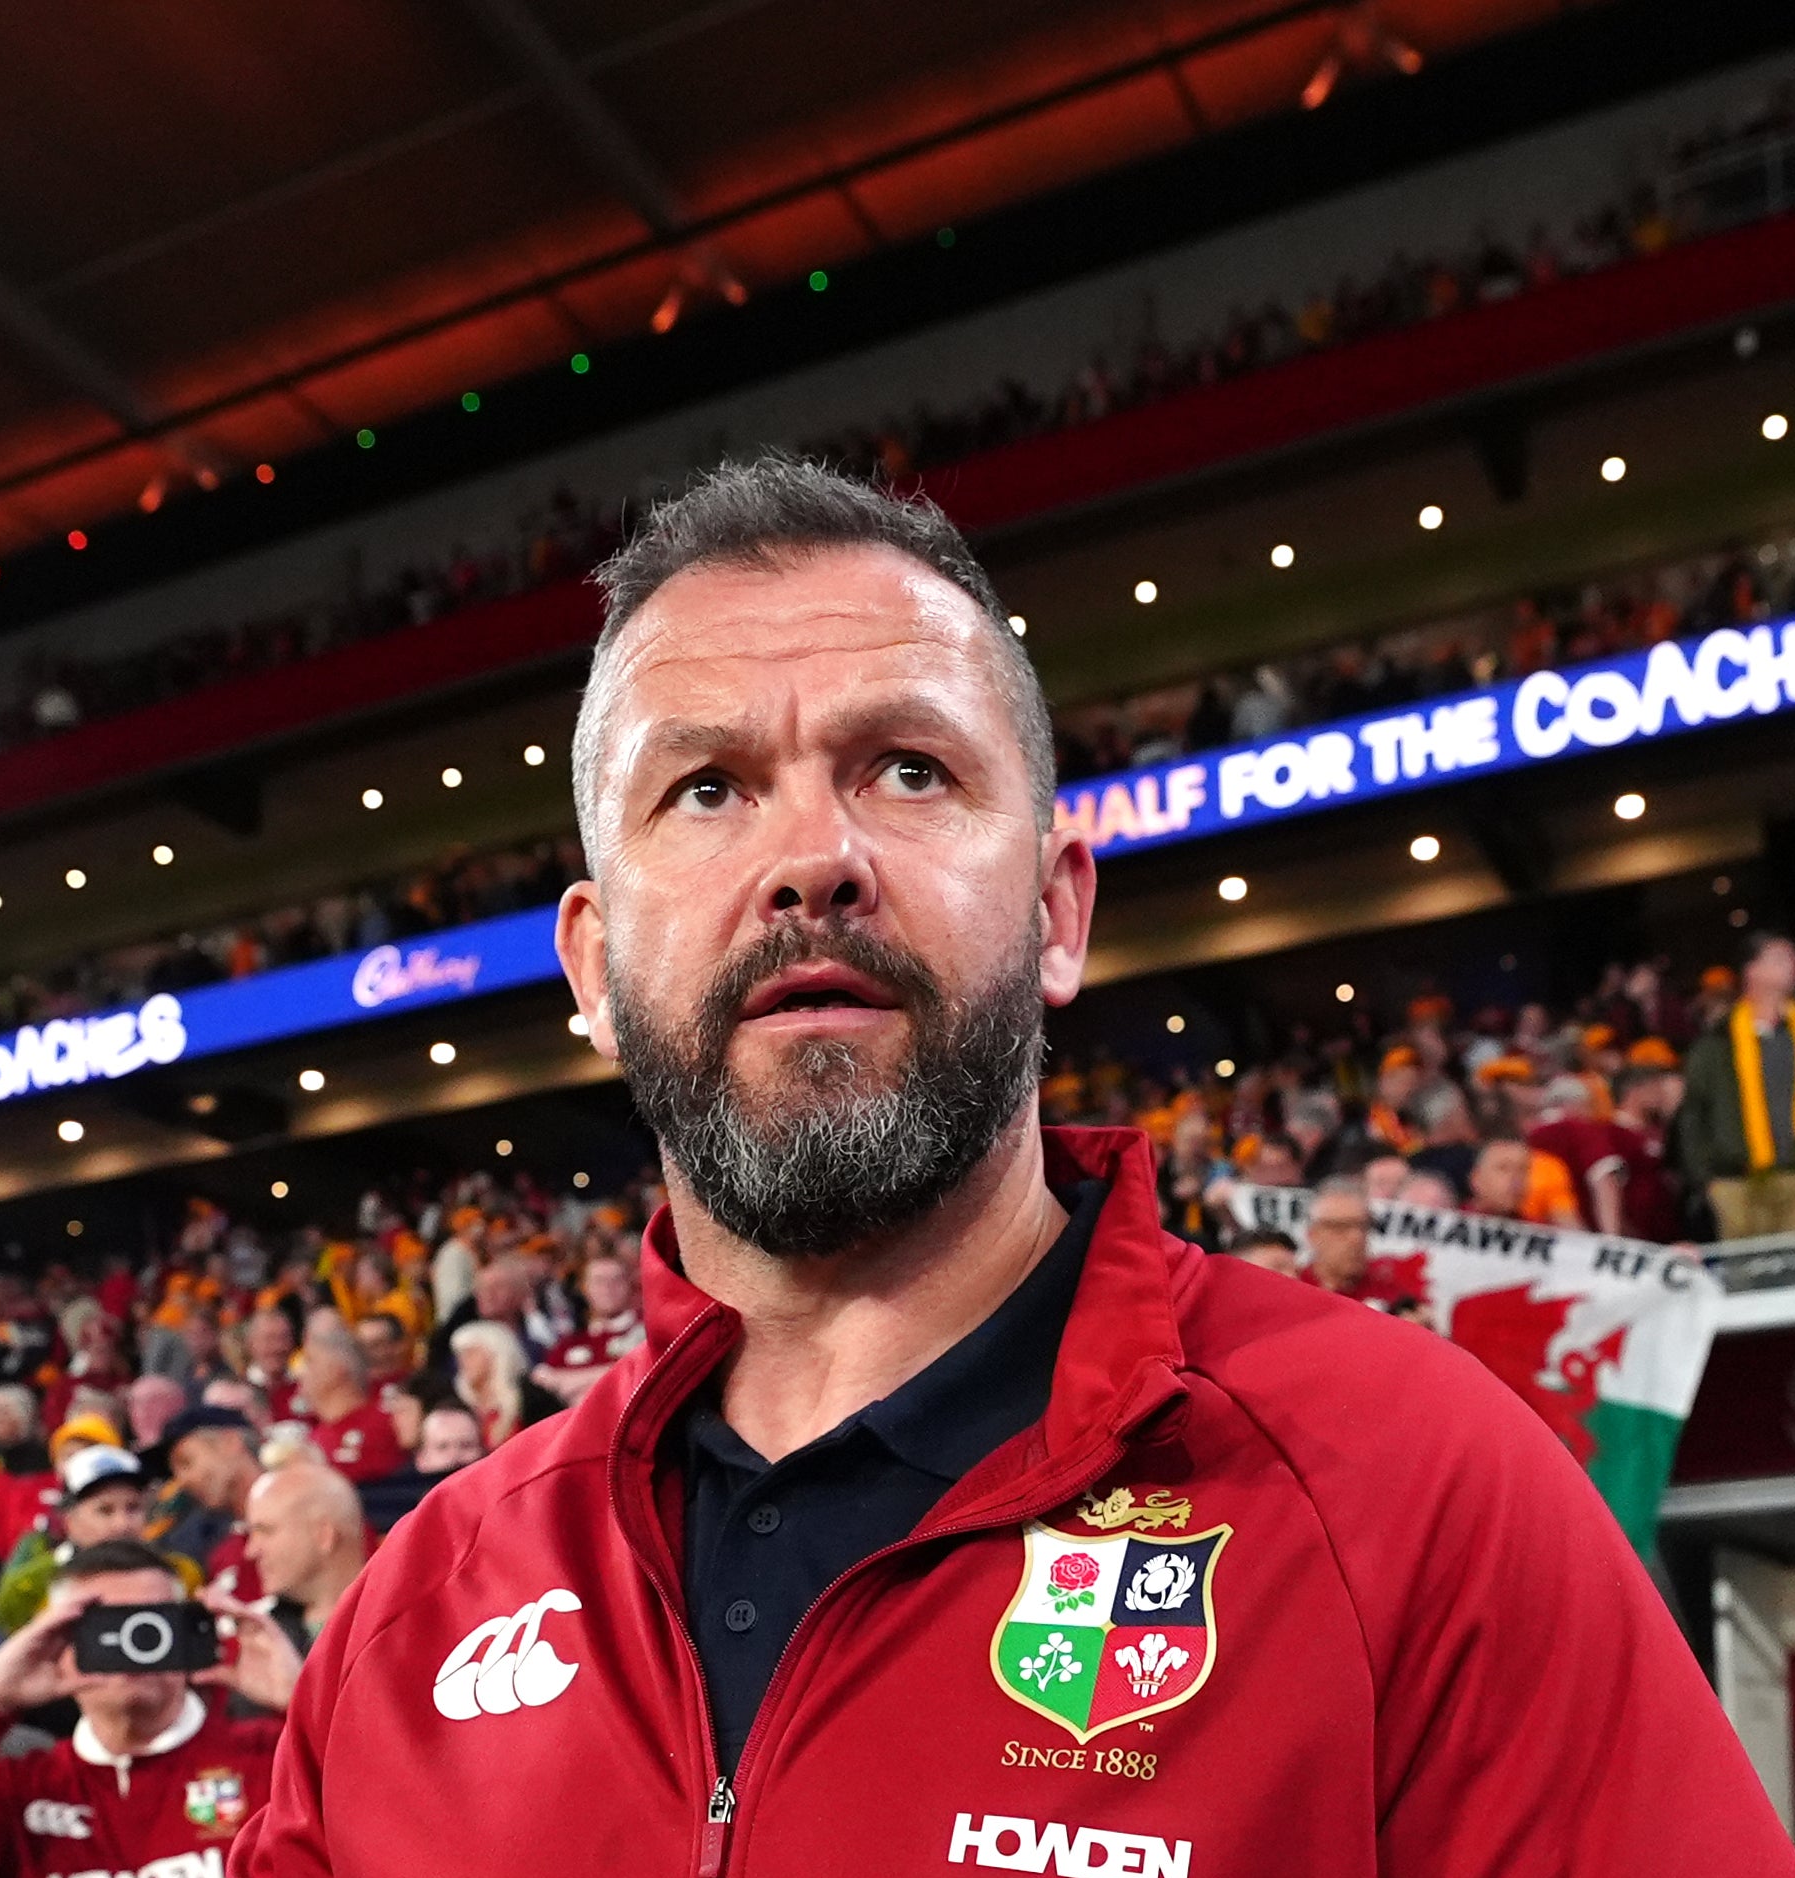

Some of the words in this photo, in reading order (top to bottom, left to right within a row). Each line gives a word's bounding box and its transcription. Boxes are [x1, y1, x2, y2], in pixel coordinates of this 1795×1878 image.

[1218, 731, 1358, 819] FOR
[1357, 696, 1502, 784] THE
[1093, 1747, 1158, 1781] 1888
